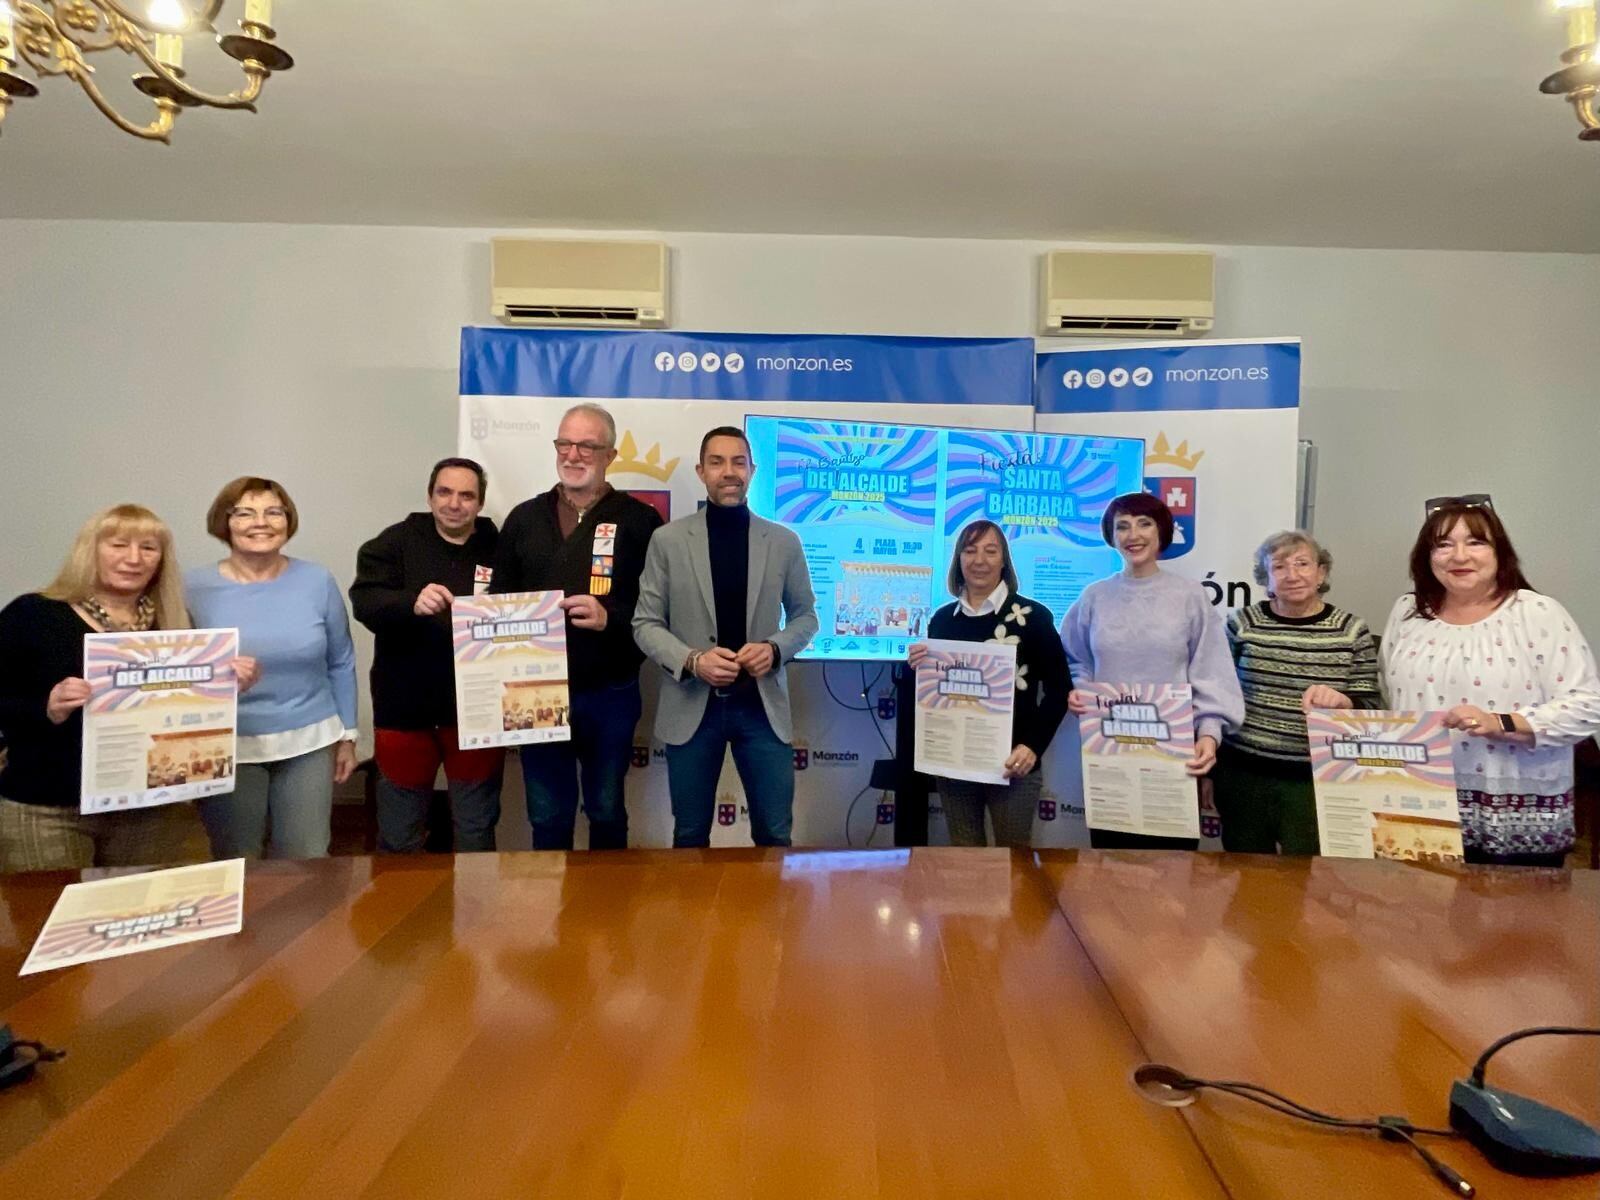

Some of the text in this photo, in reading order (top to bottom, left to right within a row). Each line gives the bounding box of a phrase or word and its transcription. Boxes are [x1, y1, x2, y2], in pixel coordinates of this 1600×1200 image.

[757, 357, 853, 371] monzon.es
[1166, 366, 1269, 382] monzon.es
[491, 419, 540, 432] Monzón
[807, 470, 908, 493] DEL ALCALDE
[1004, 469, 1061, 490] SANTA
[989, 491, 1075, 517] BÁRBARA
[855, 538, 863, 549] 4
[875, 539, 896, 547] PLAZA
[873, 547, 897, 555] MAYOR
[474, 620, 547, 639] DEL ALCALDE
[116, 670, 145, 687] DEL
[147, 665, 211, 682] ALCALDE
[1112, 704, 1157, 721] SANTA
[812, 750, 859, 761] Monzón
[1333, 742, 1425, 762] DEL ALCALDE
